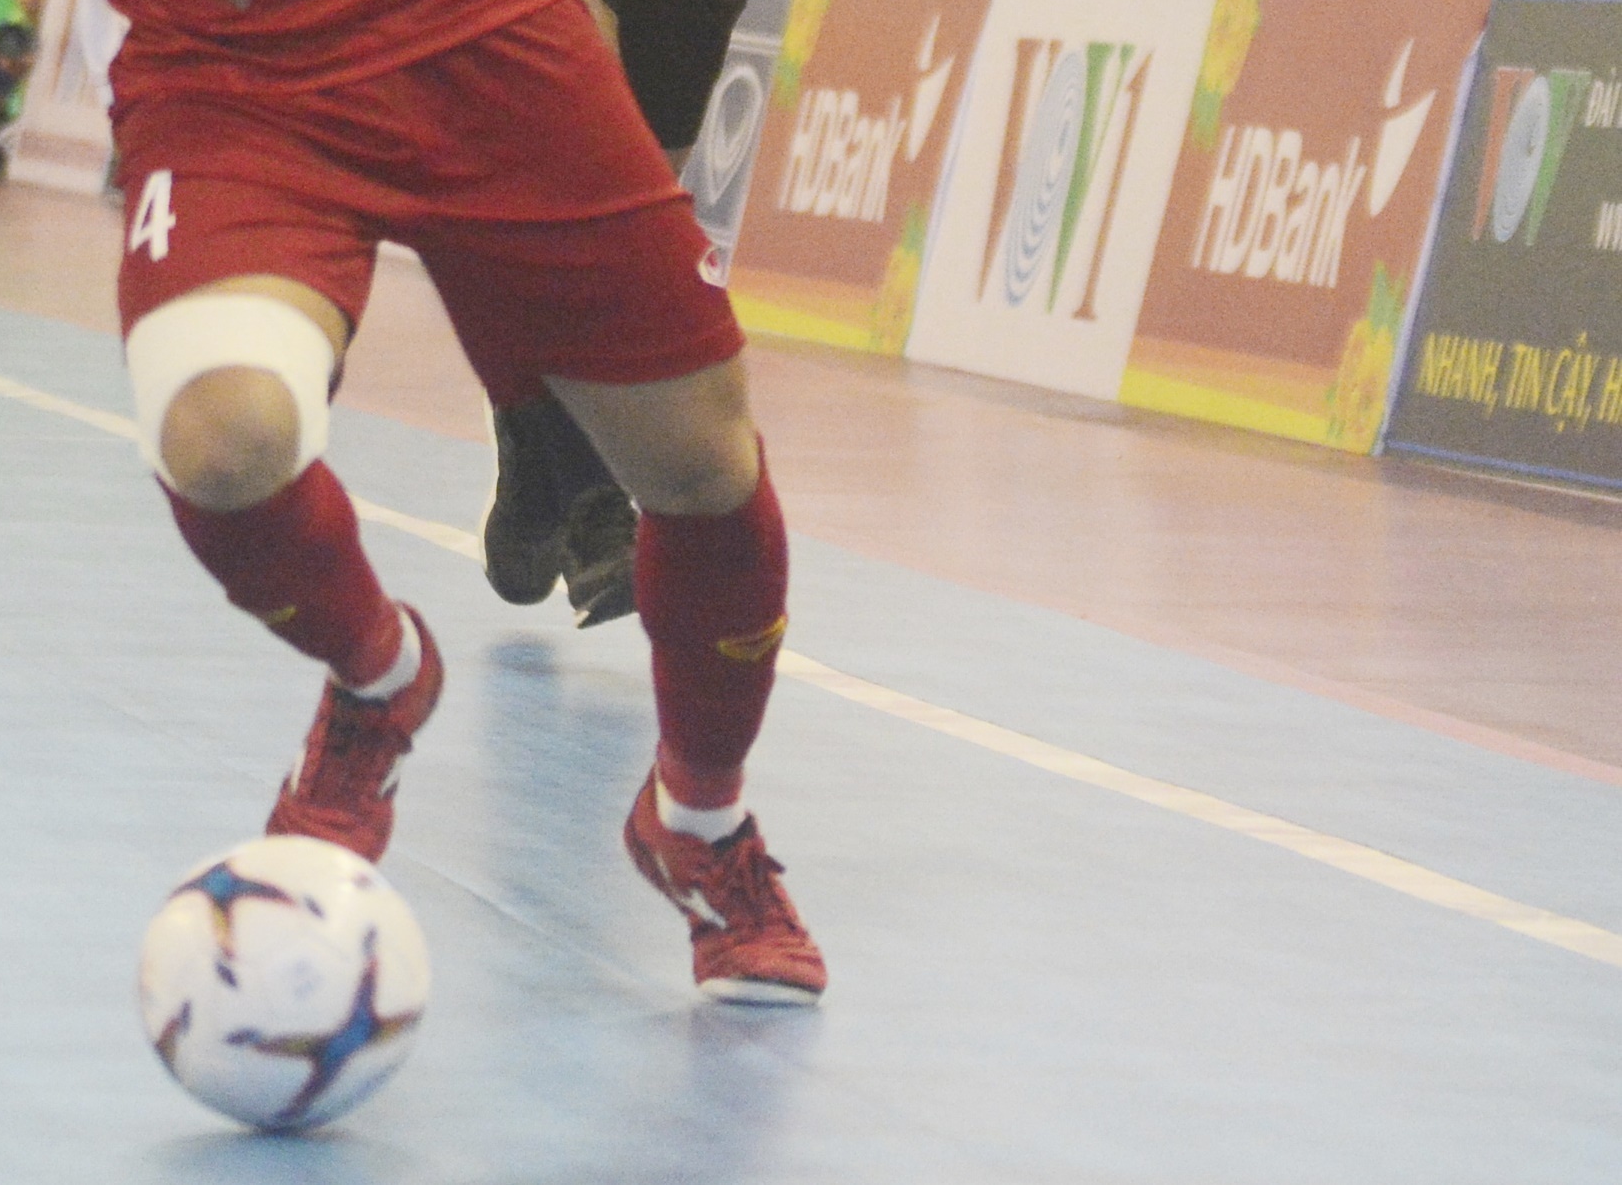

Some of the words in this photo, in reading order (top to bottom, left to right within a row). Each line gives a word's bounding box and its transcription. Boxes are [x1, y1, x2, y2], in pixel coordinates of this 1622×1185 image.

[778, 87, 907, 224] HDBank
[1191, 125, 1367, 290] HDBank
[129, 169, 176, 261] 4
[1505, 344, 1552, 410] TIN
